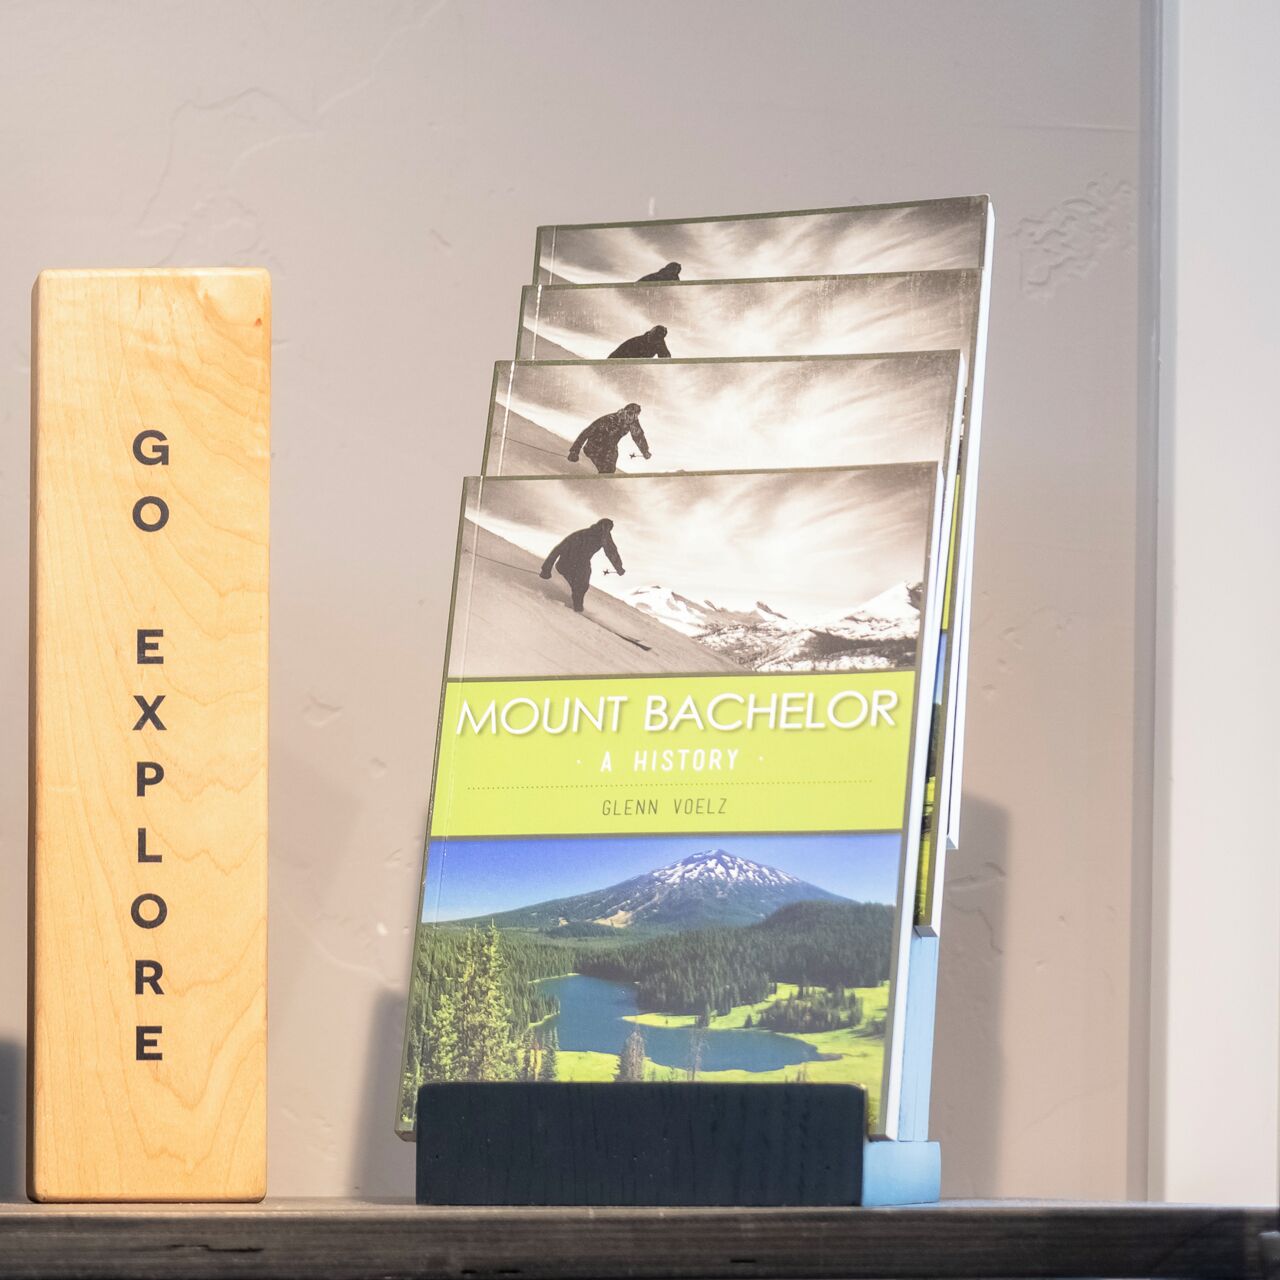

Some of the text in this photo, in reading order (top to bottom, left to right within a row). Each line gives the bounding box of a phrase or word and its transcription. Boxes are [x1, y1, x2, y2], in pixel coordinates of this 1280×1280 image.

[455, 689, 898, 737] MOUNT BACHELOR
[130, 429, 170, 1062] GO EXPLORE
[600, 749, 739, 772] A HISTORY
[602, 798, 728, 816] GLENN VOELZ
